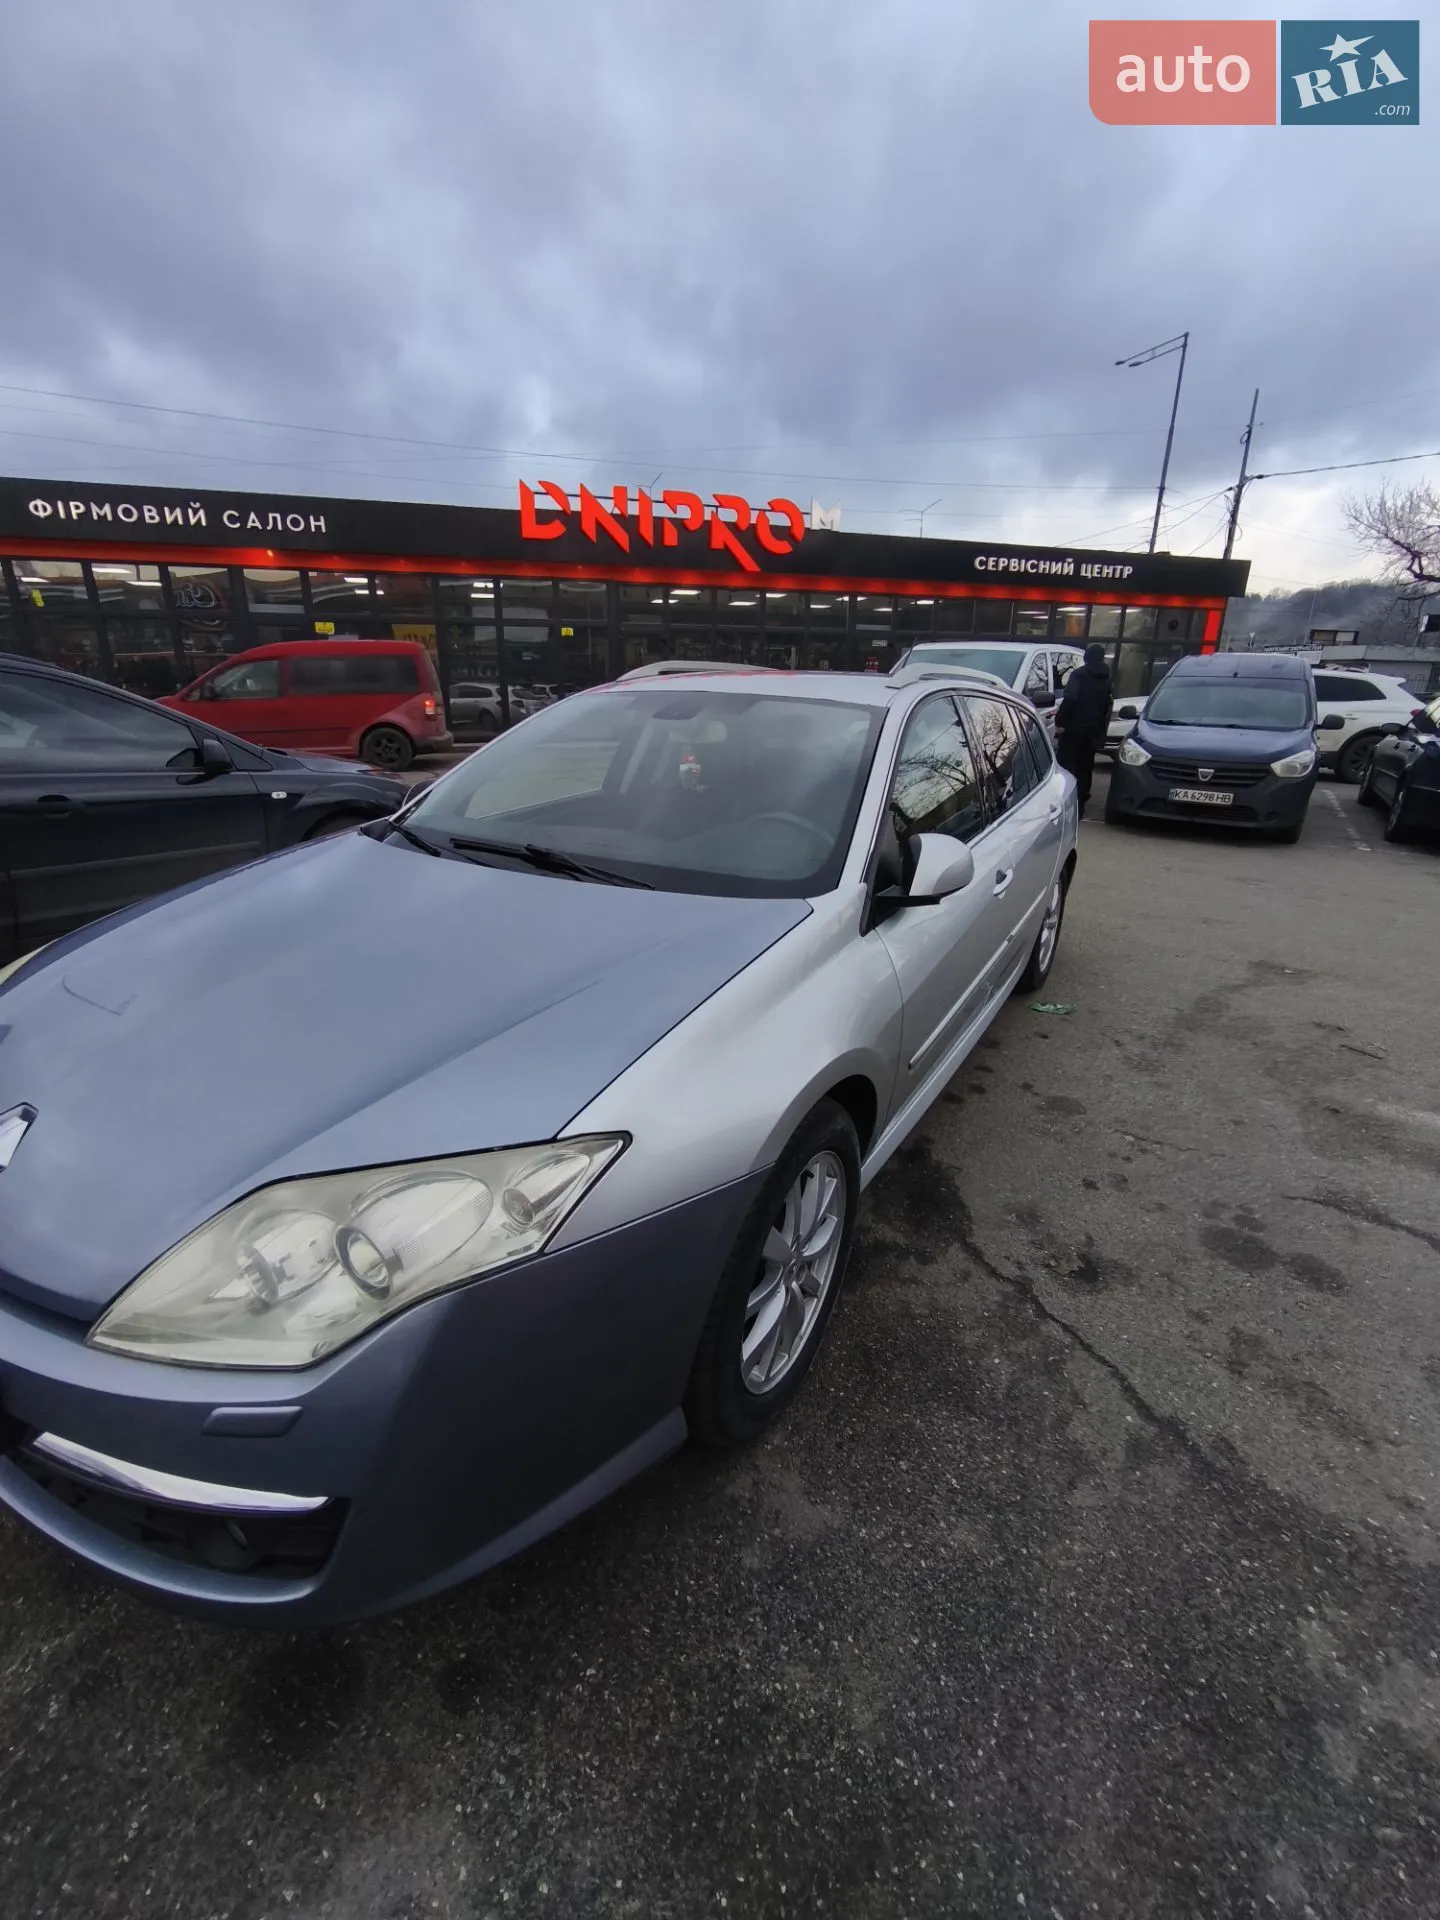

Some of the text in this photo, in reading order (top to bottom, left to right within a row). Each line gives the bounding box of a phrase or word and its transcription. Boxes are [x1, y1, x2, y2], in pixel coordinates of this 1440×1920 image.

[28, 498, 327, 534] ФІРМОВИЙ САЛОН
[519, 479, 841, 572] DNIPRO M
[973, 556, 1133, 579] СЕРВІСНИЙ ЦЕНТР
